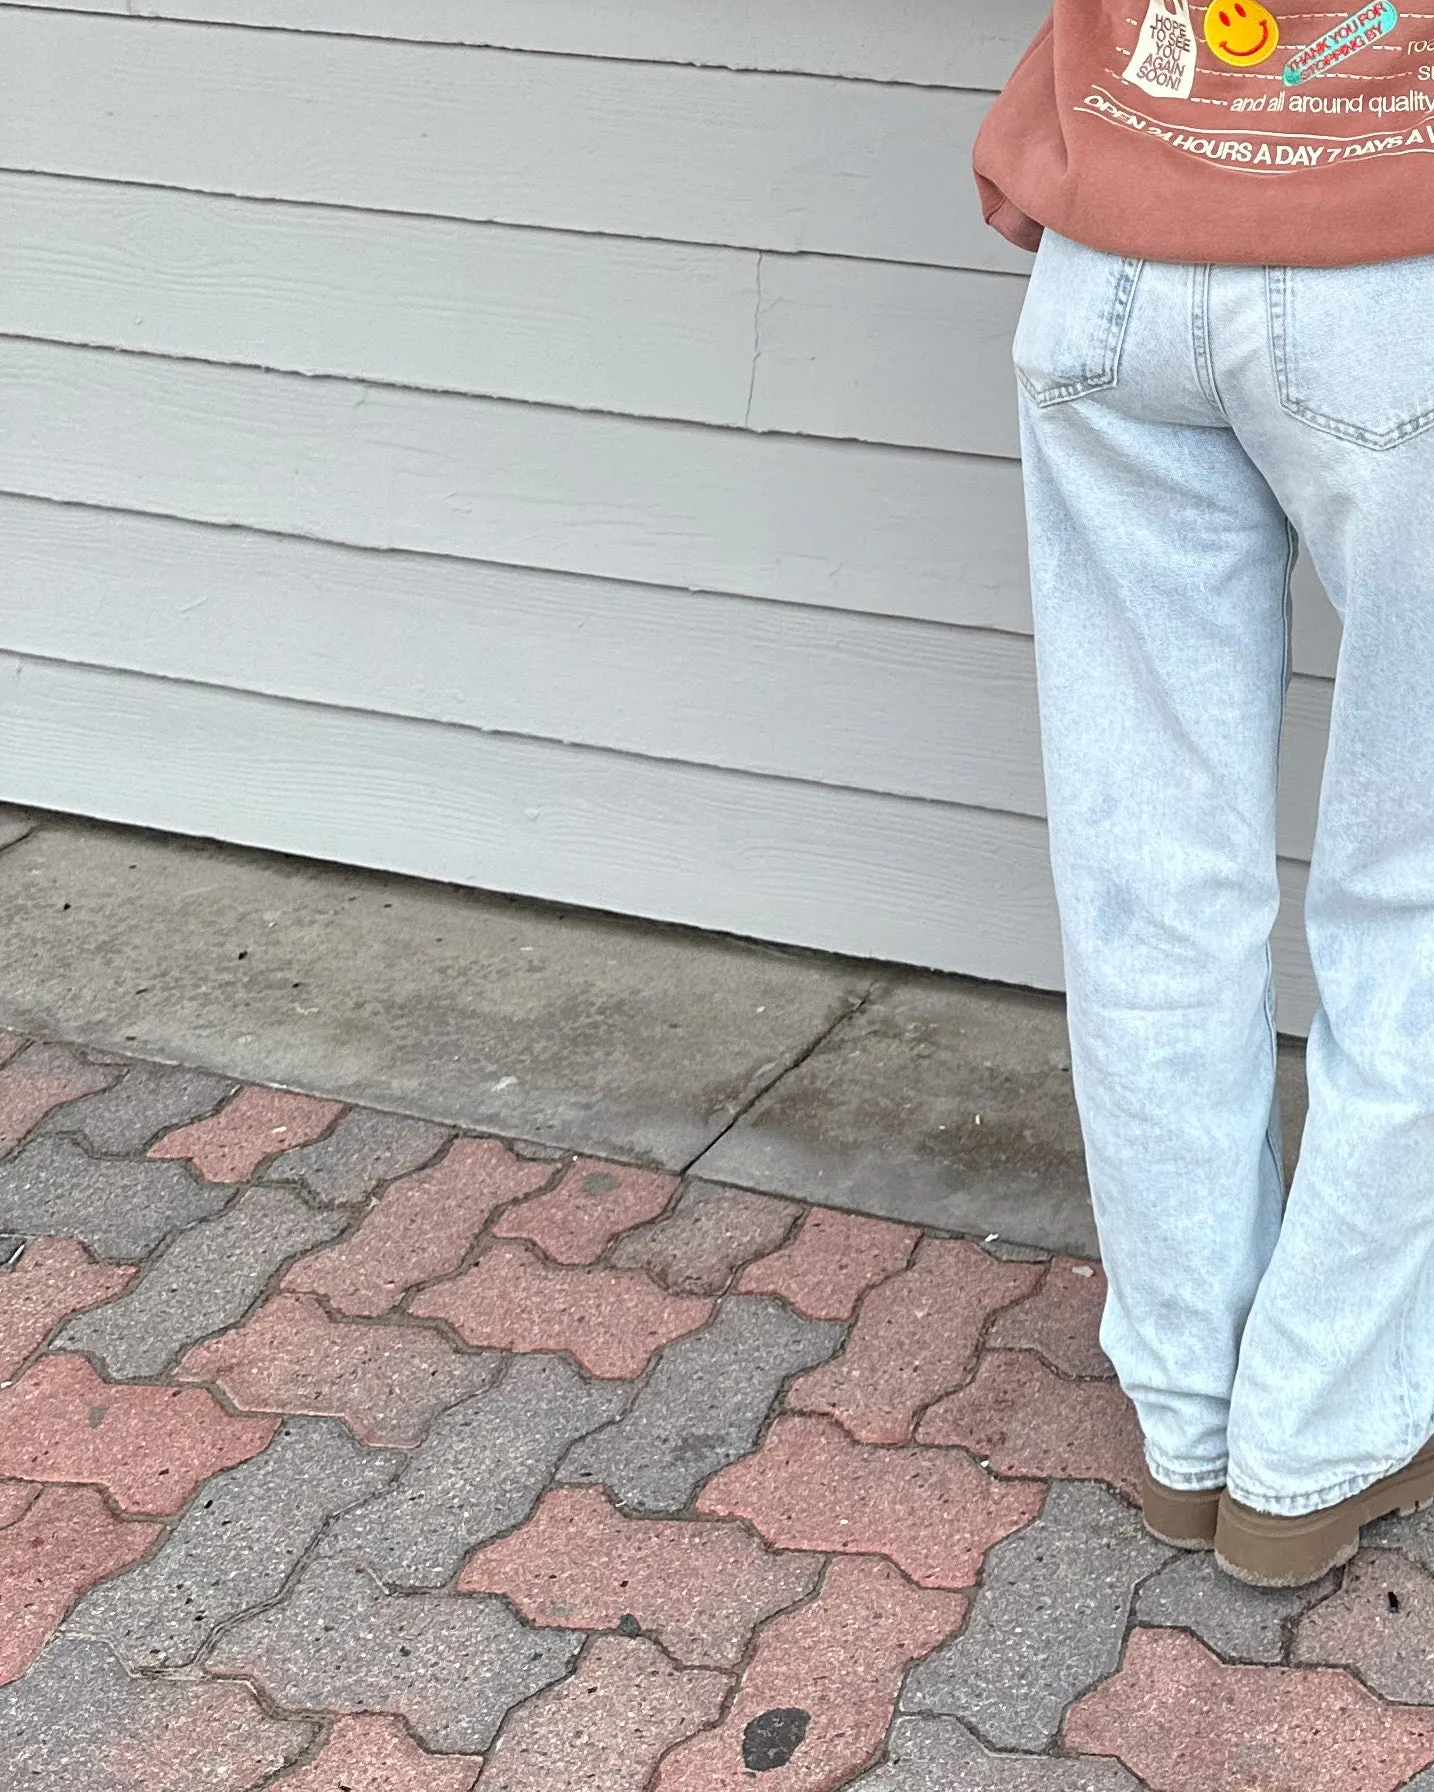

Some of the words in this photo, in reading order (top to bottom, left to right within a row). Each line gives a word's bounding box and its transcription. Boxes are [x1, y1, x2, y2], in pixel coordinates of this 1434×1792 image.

[1150, 25, 1167, 42] TO
[1168, 33, 1192, 53] SEE
[1155, 13, 1187, 39] HOPE
[1289, 37, 1331, 72] THANK
[1328, 19, 1359, 44] YOU
[1357, 1, 1387, 26] FOR
[1363, 21, 1383, 42] BY
[1155, 42, 1182, 62] YOU
[1143, 54, 1186, 77] AGAIN
[1137, 66, 1182, 92] SOON!
[1231, 94, 1266, 112] and
[1268, 91, 1285, 110] all
[1289, 91, 1364, 113] around
[1083, 93, 1147, 131] OPEN
[1174, 135, 1253, 163] HOURS
[1253, 142, 1275, 165] A
[1275, 146, 1321, 167] DAY
[1327, 148, 1341, 164] 7
[1342, 137, 1403, 160] DAYS
[1402, 129, 1425, 145] A
